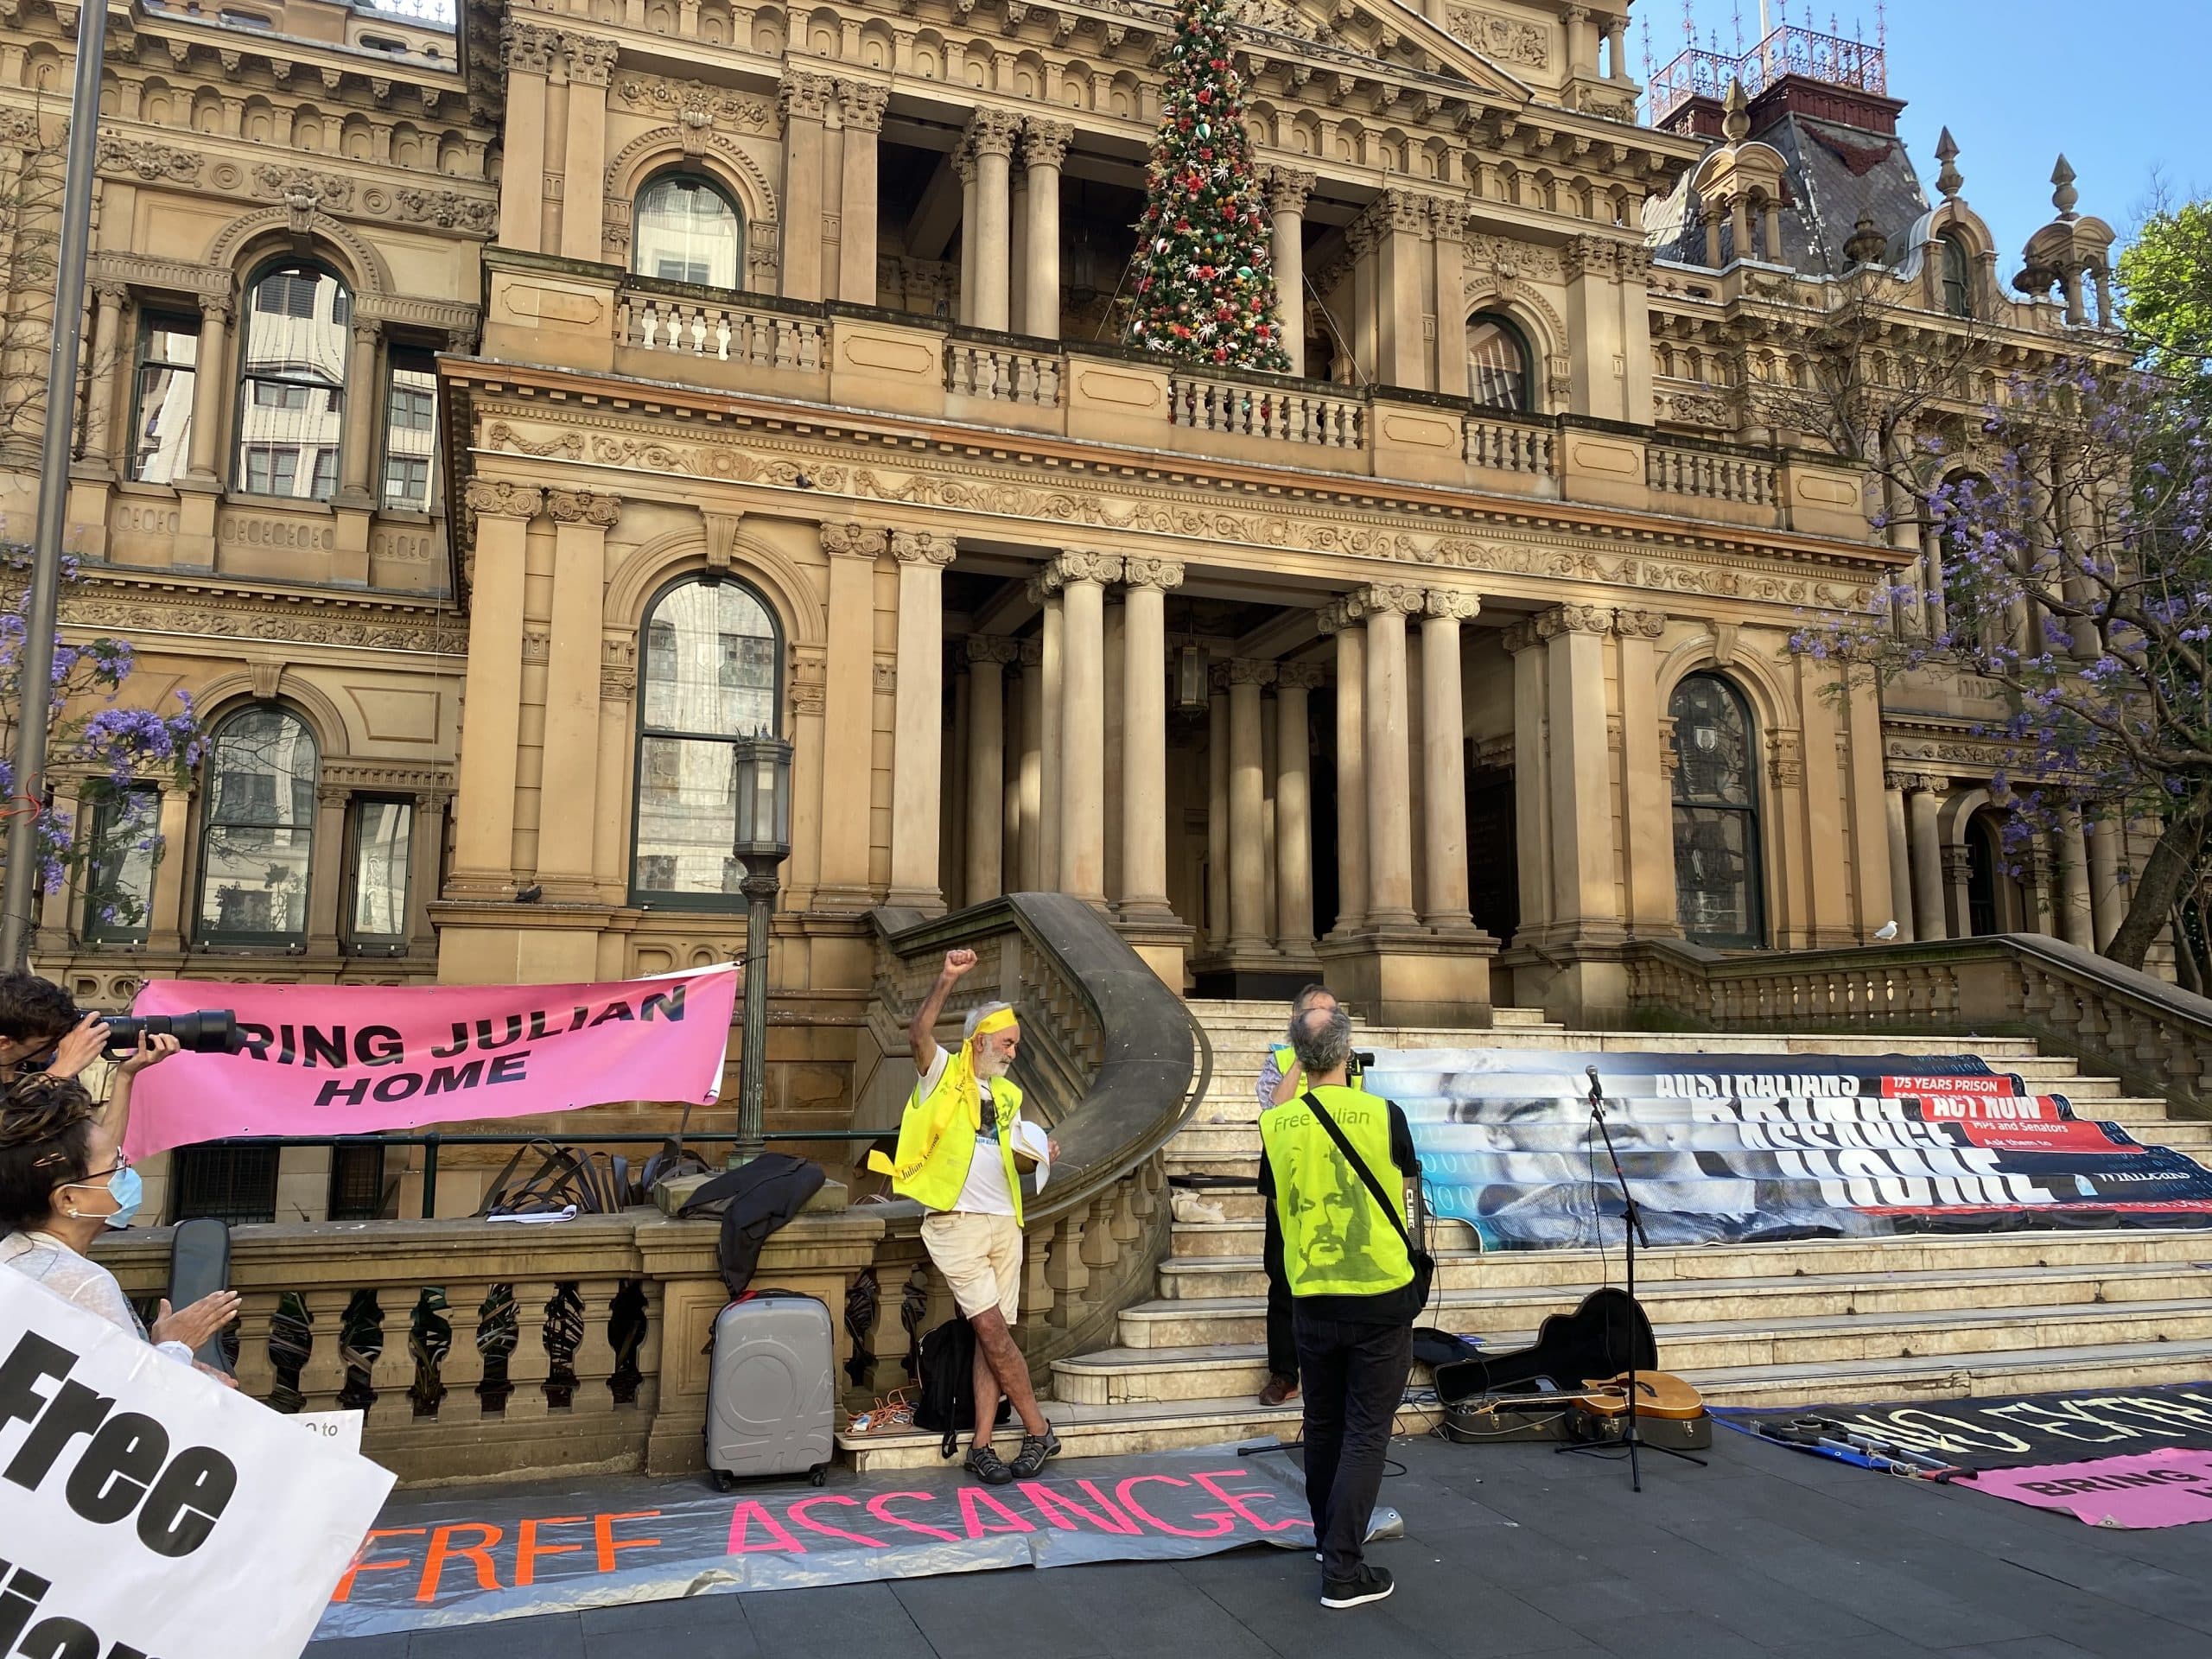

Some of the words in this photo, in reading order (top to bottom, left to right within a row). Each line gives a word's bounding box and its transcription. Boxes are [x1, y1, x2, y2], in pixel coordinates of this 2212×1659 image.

[235, 1023, 404, 1068] RING
[431, 985, 685, 1058] JULIAN
[313, 1050, 531, 1106] HOME
[1893, 1077, 1912, 1089] 175
[1914, 1077, 1952, 1090] YEARS
[1955, 1079, 1998, 1092] PRISON
[1933, 1096, 1977, 1118] ACT
[1274, 1113, 1311, 1133] Free
[1998, 1122, 2018, 1131] and
[2018, 1122, 2069, 1134] Senators
[0, 1330, 238, 1558] Free
[2014, 1469, 2210, 1497] BRING
